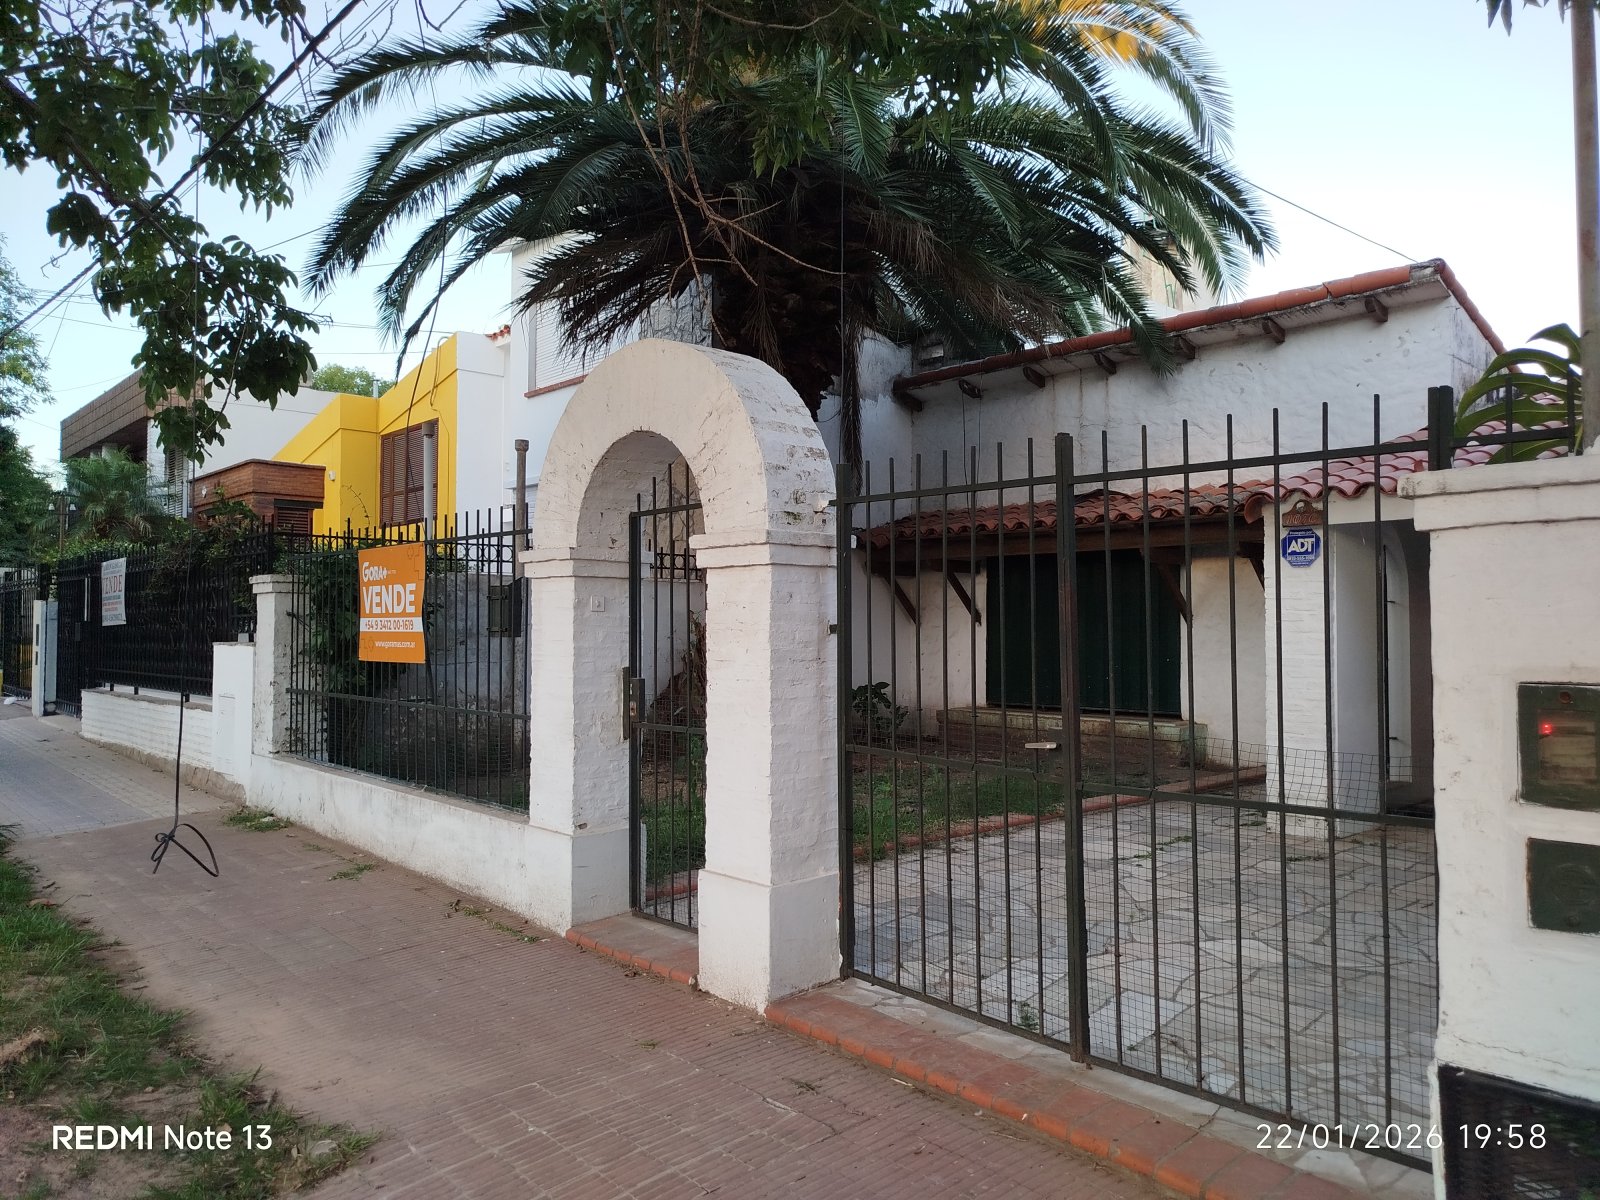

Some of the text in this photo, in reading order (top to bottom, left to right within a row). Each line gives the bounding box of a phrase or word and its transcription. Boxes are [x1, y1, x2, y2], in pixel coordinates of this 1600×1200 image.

[1288, 538, 1315, 553] ADT
[363, 583, 416, 614] VENDE
[379, 619, 392, 630] 3412
